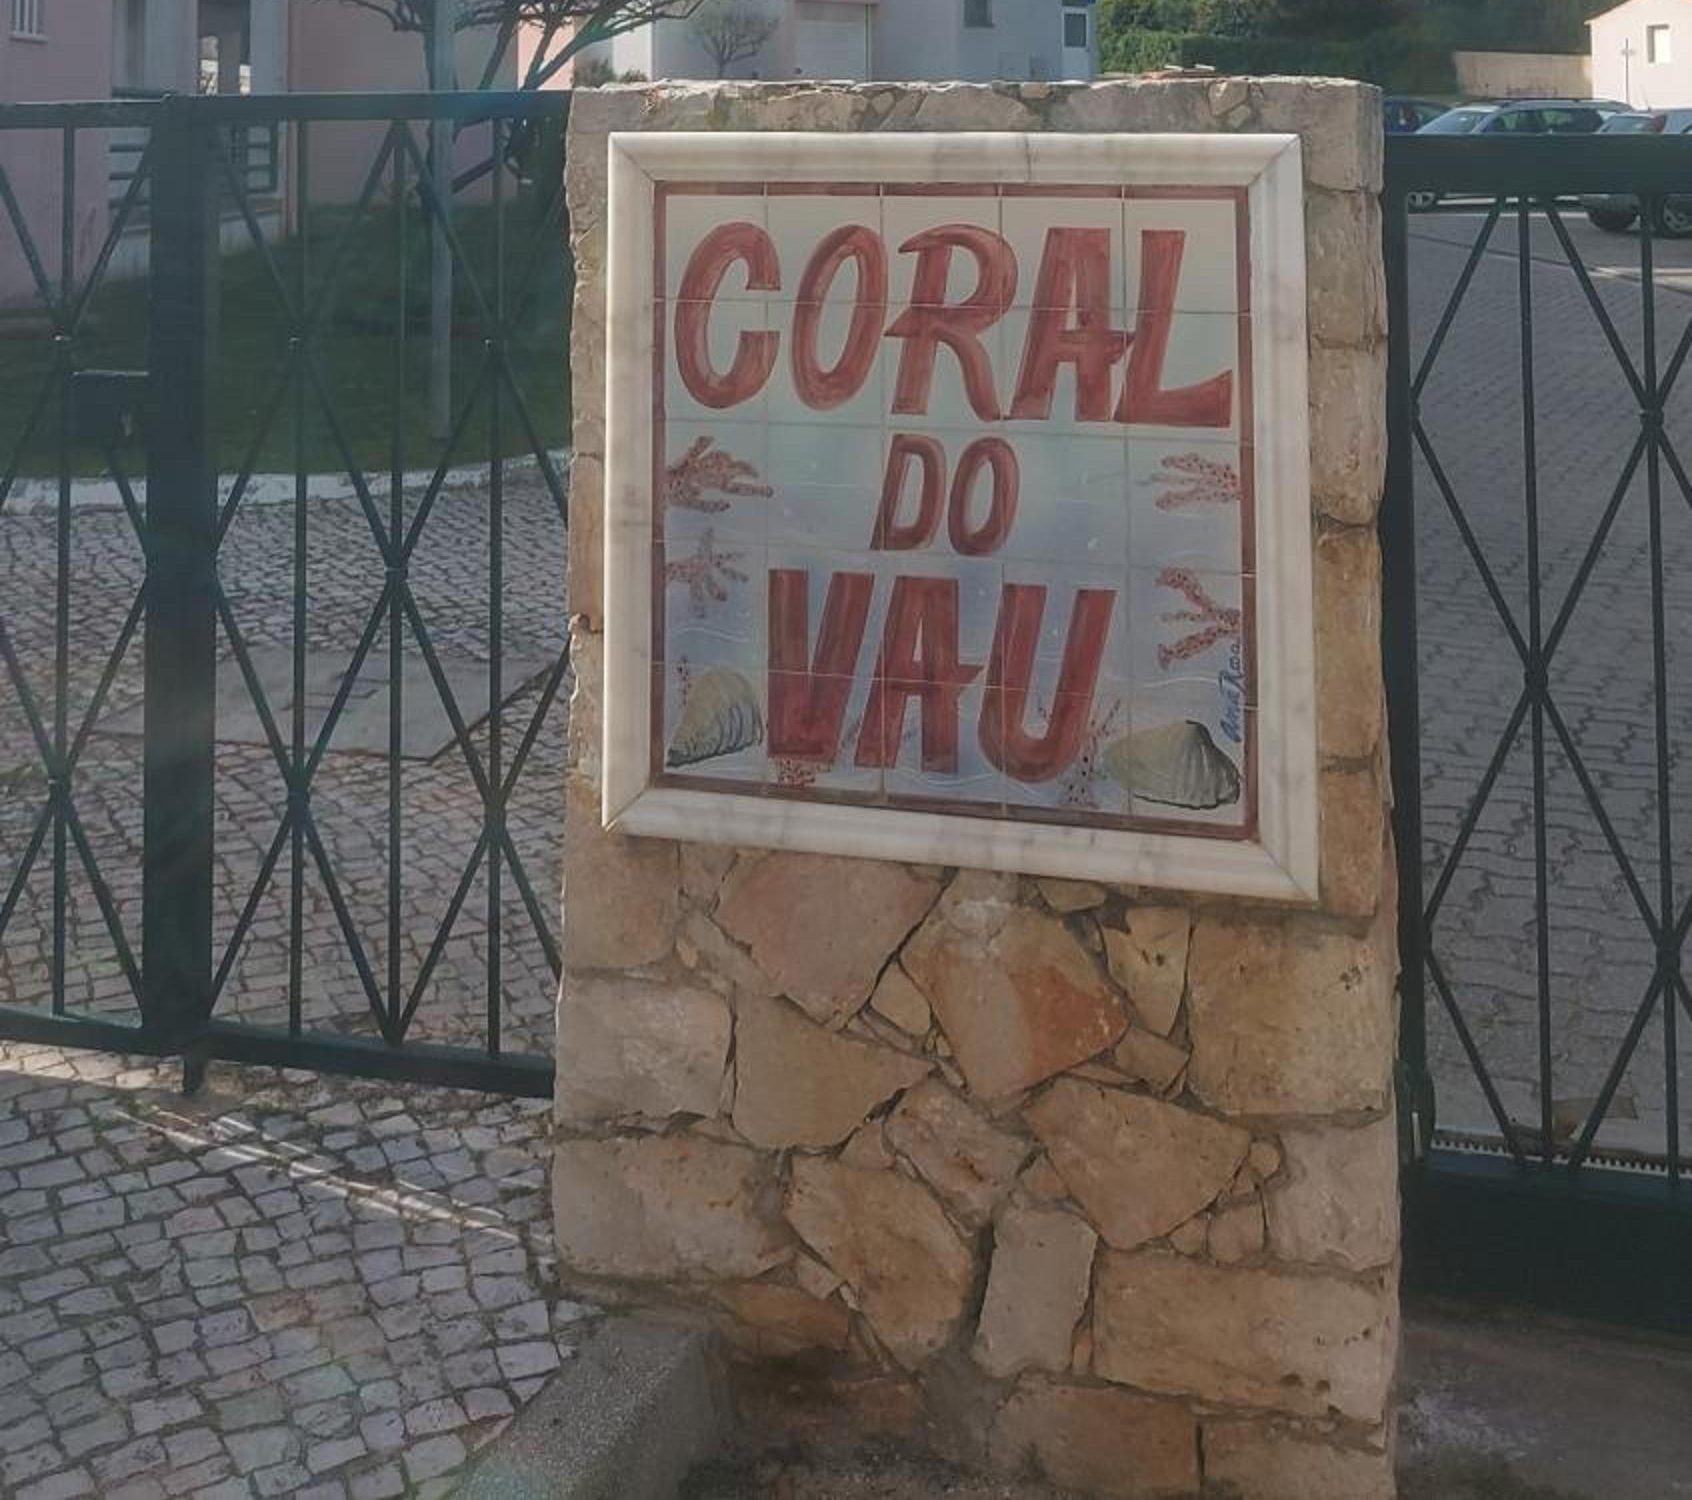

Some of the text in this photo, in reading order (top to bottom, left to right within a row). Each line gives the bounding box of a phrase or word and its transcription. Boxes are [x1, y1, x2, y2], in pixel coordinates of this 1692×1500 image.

[674, 221, 1234, 428] CORAL
[870, 433, 1020, 556] DO
[767, 568, 1117, 783] VAU
